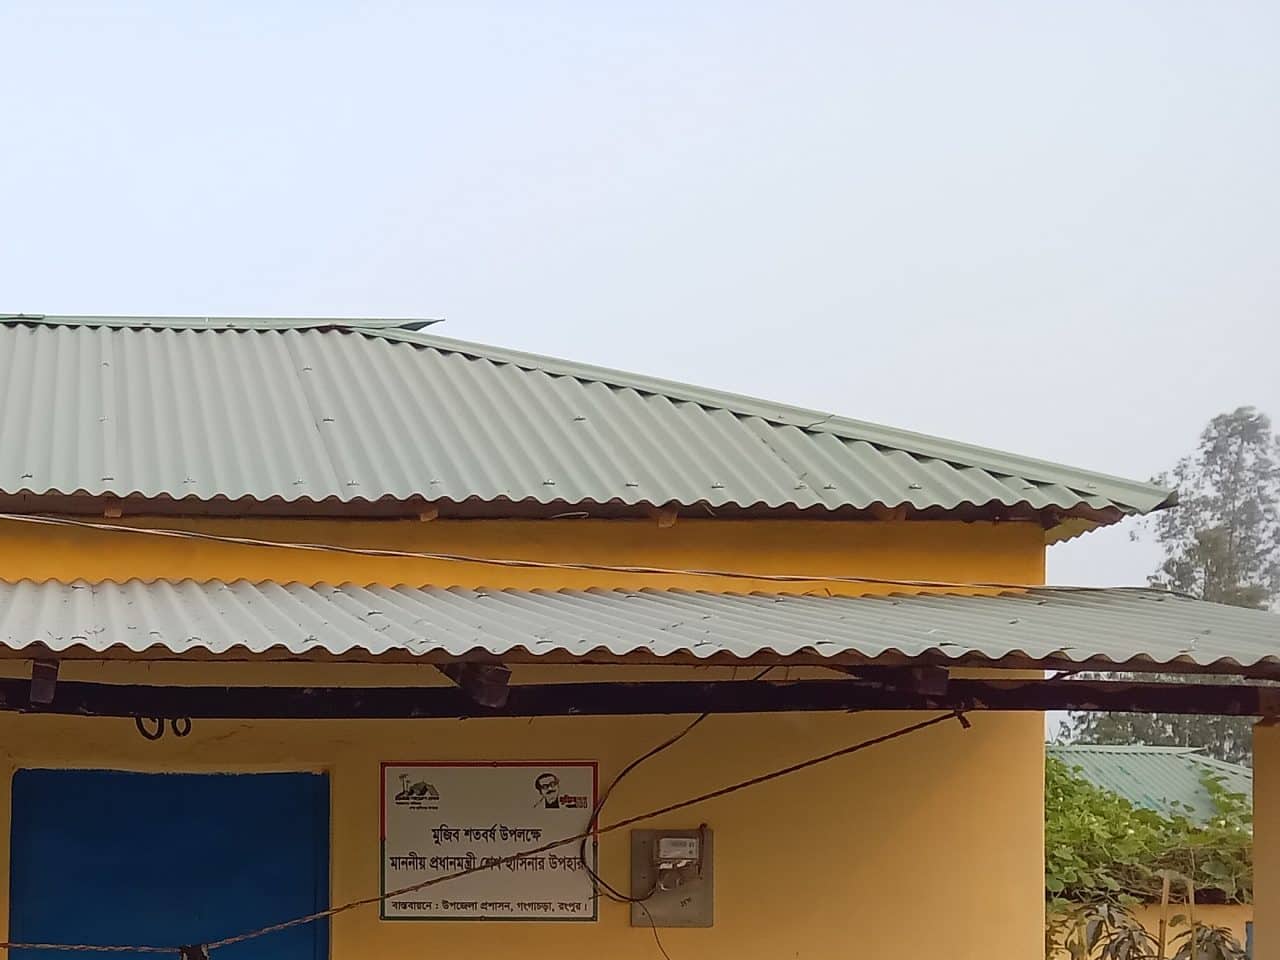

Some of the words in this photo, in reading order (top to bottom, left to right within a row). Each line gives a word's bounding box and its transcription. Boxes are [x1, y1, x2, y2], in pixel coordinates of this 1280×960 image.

[431, 823, 461, 846] মুজিব
[463, 823, 497, 843] শতবর্ষ
[499, 823, 542, 843] উপলক্ষে
[389, 851, 427, 871] মাননীয়
[429, 851, 477, 873] প্রধানমন্ত্রী
[548, 854, 585, 872] উপহার
